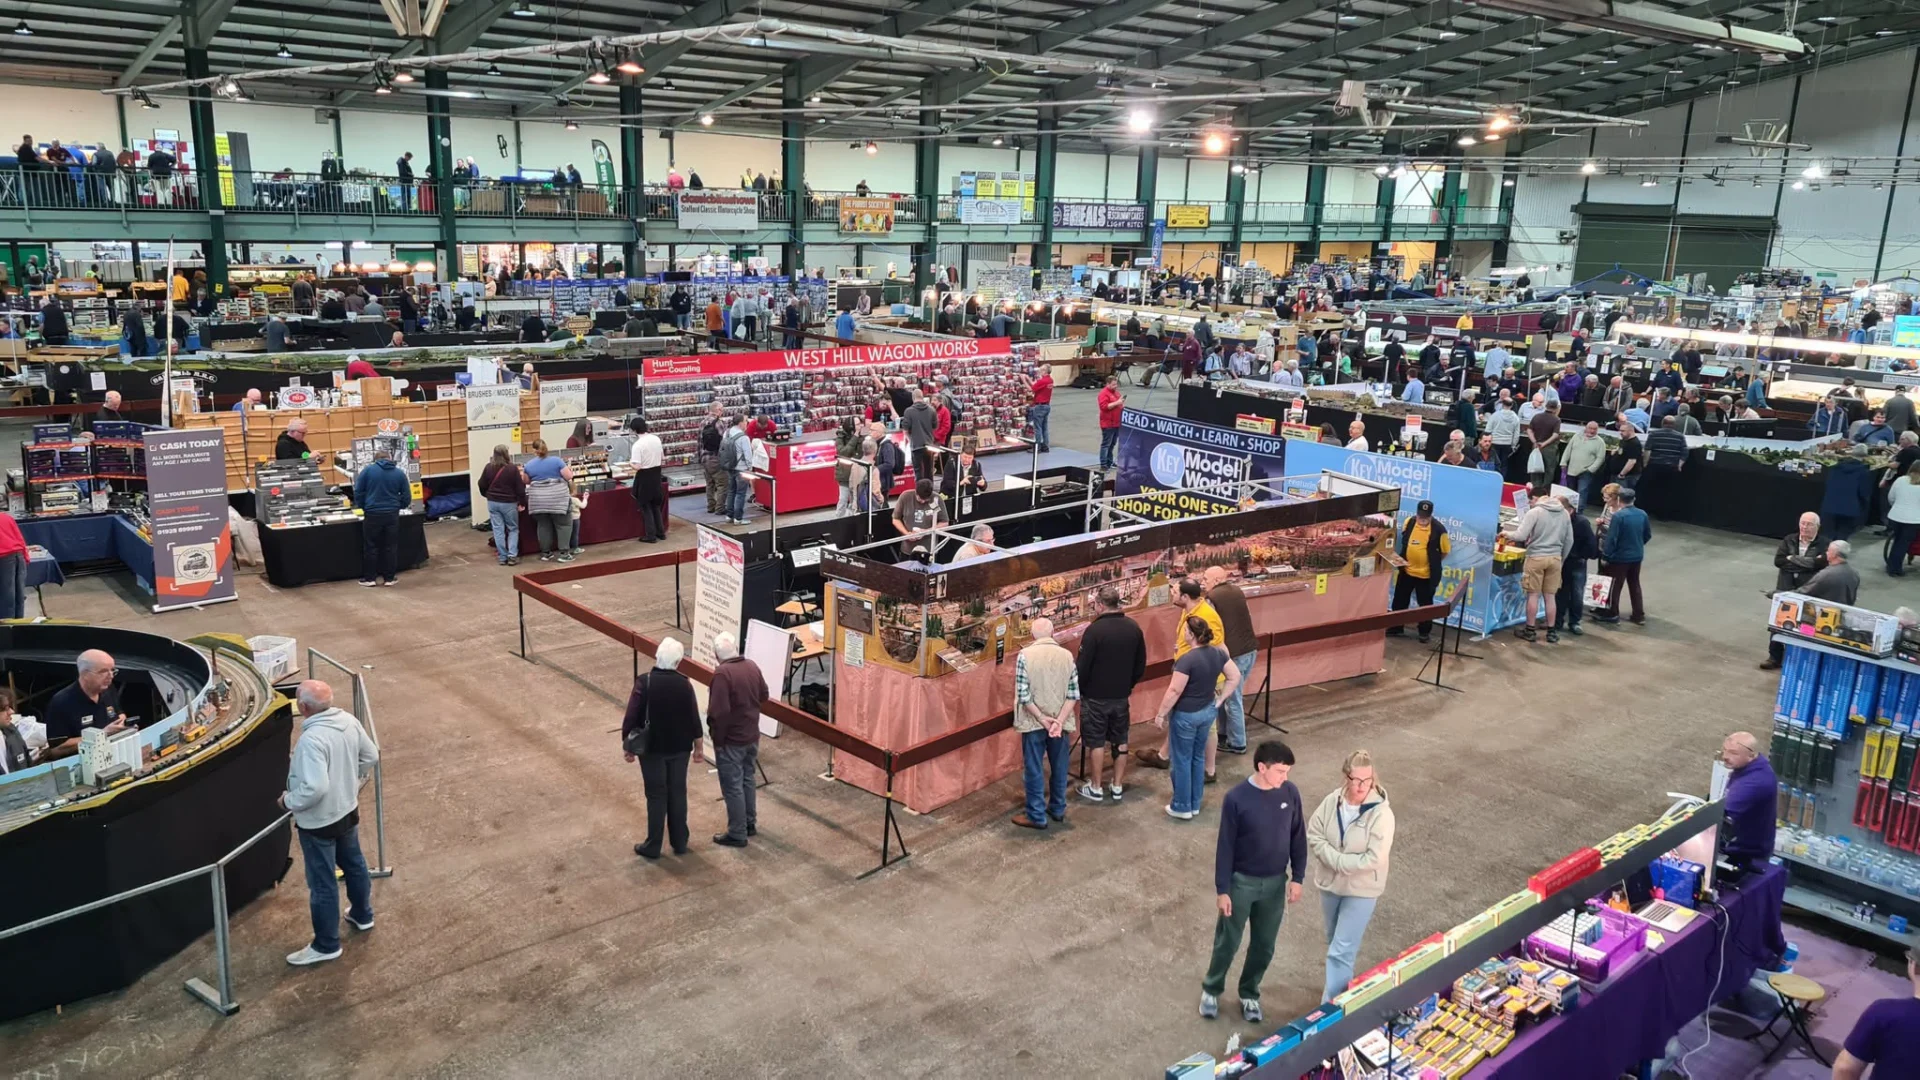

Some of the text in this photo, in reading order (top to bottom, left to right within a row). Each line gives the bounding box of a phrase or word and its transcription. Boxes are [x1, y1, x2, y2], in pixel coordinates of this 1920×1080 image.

[681, 205, 700, 213] Stafford
[701, 205, 717, 213] Classic
[718, 206, 743, 216] Motorcycle
[1070, 204, 1107, 227] MEALS
[652, 359, 673, 368] Hunt
[784, 340, 979, 367] WEST HILL WAGON WORKS
[668, 365, 700, 373] Coupling
[468, 390, 492, 398] BRUSHES
[497, 388, 518, 396] MODELS
[541, 385, 563, 394] BRUSHES
[567, 383, 586, 391] MODELS
[1121, 411, 1280, 454] READ WATCH LEARN SHOP
[160, 439, 220, 450] CASH TODAY
[1156, 449, 1180, 475] KEY
[1185, 450, 1239, 478] Model
[1351, 458, 1374, 480] KEY
[1377, 459, 1429, 482] Model
[1185, 469, 1232, 497] World
[1377, 474, 1423, 497] World
[1116, 499, 1180, 520] SHOP FOR
[1140, 485, 1176, 505] YOUR
[1179, 495, 1208, 513] ONE
[1449, 516, 1464, 527] for
[1442, 565, 1475, 584] and
